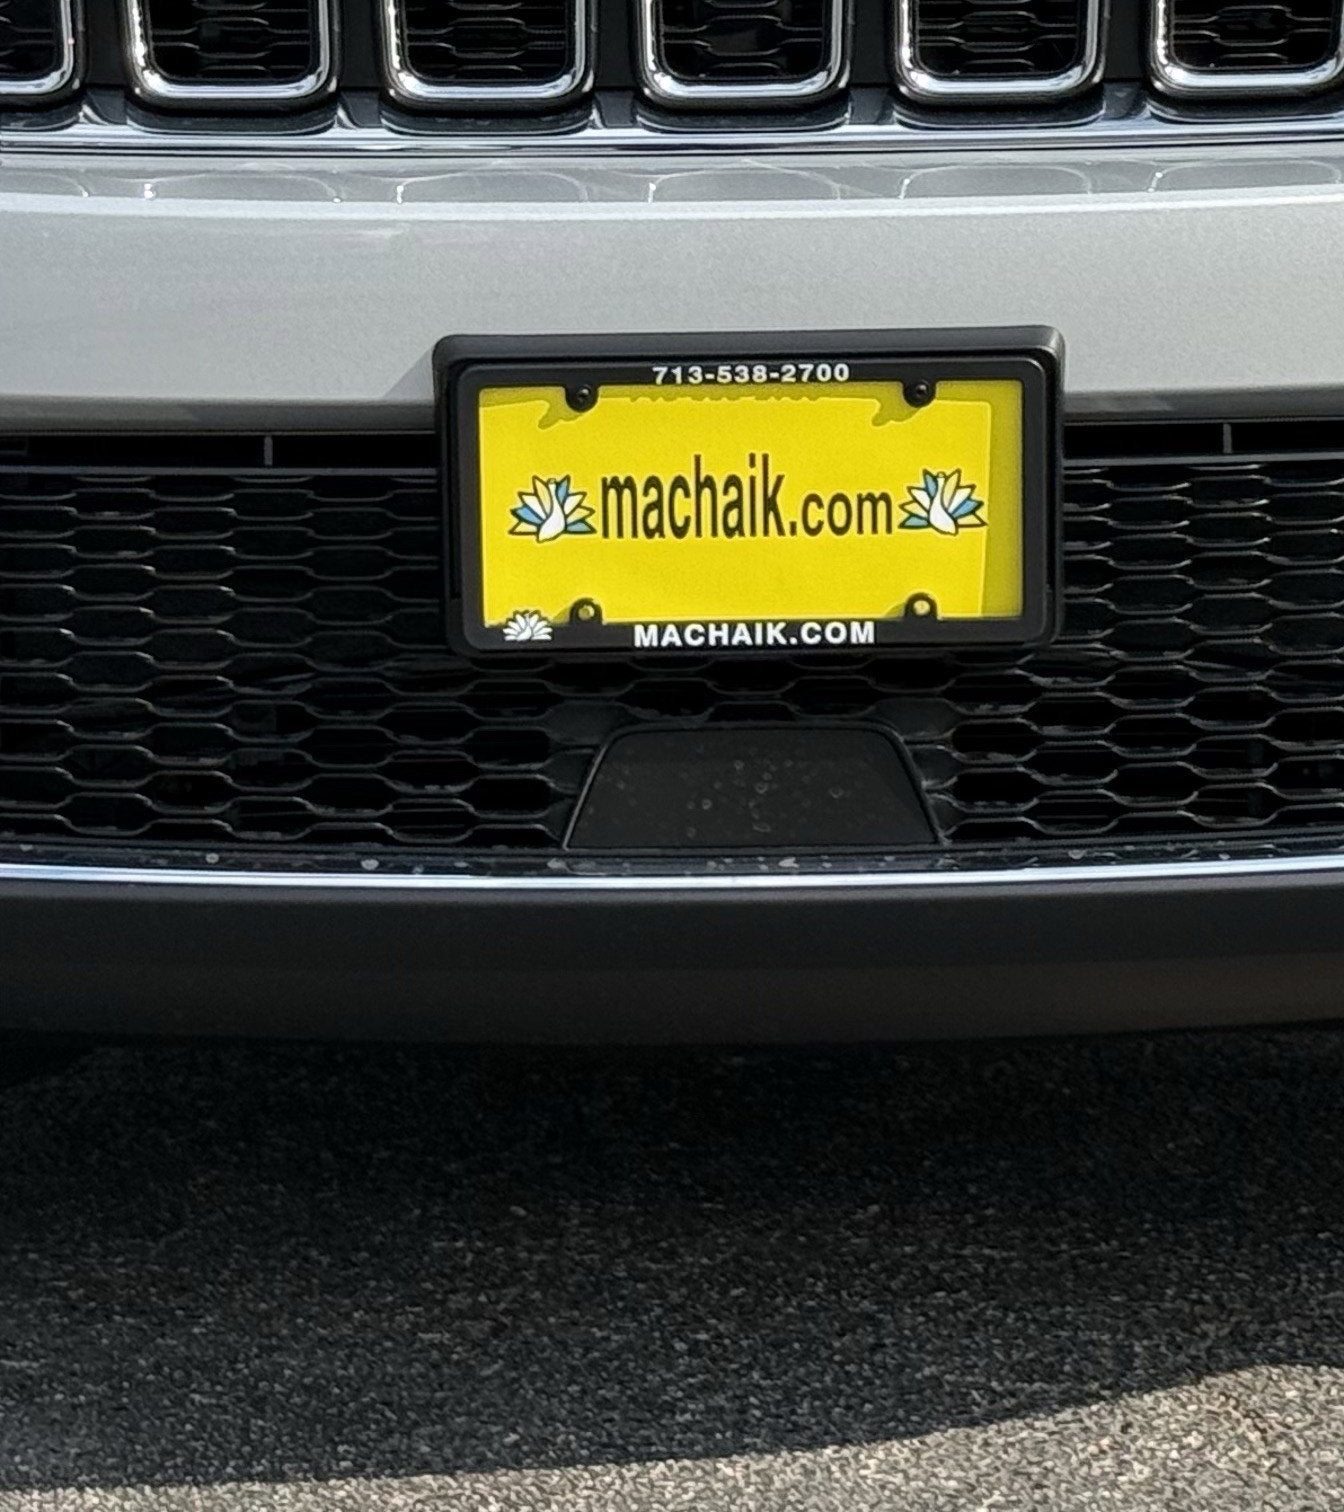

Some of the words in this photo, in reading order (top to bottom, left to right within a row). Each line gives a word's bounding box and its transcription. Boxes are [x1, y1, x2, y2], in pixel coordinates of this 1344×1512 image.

[652, 363, 850, 385] 713-538-2700
[600, 452, 893, 540] machaik.com
[633, 620, 876, 648] MACHAIK.COM
